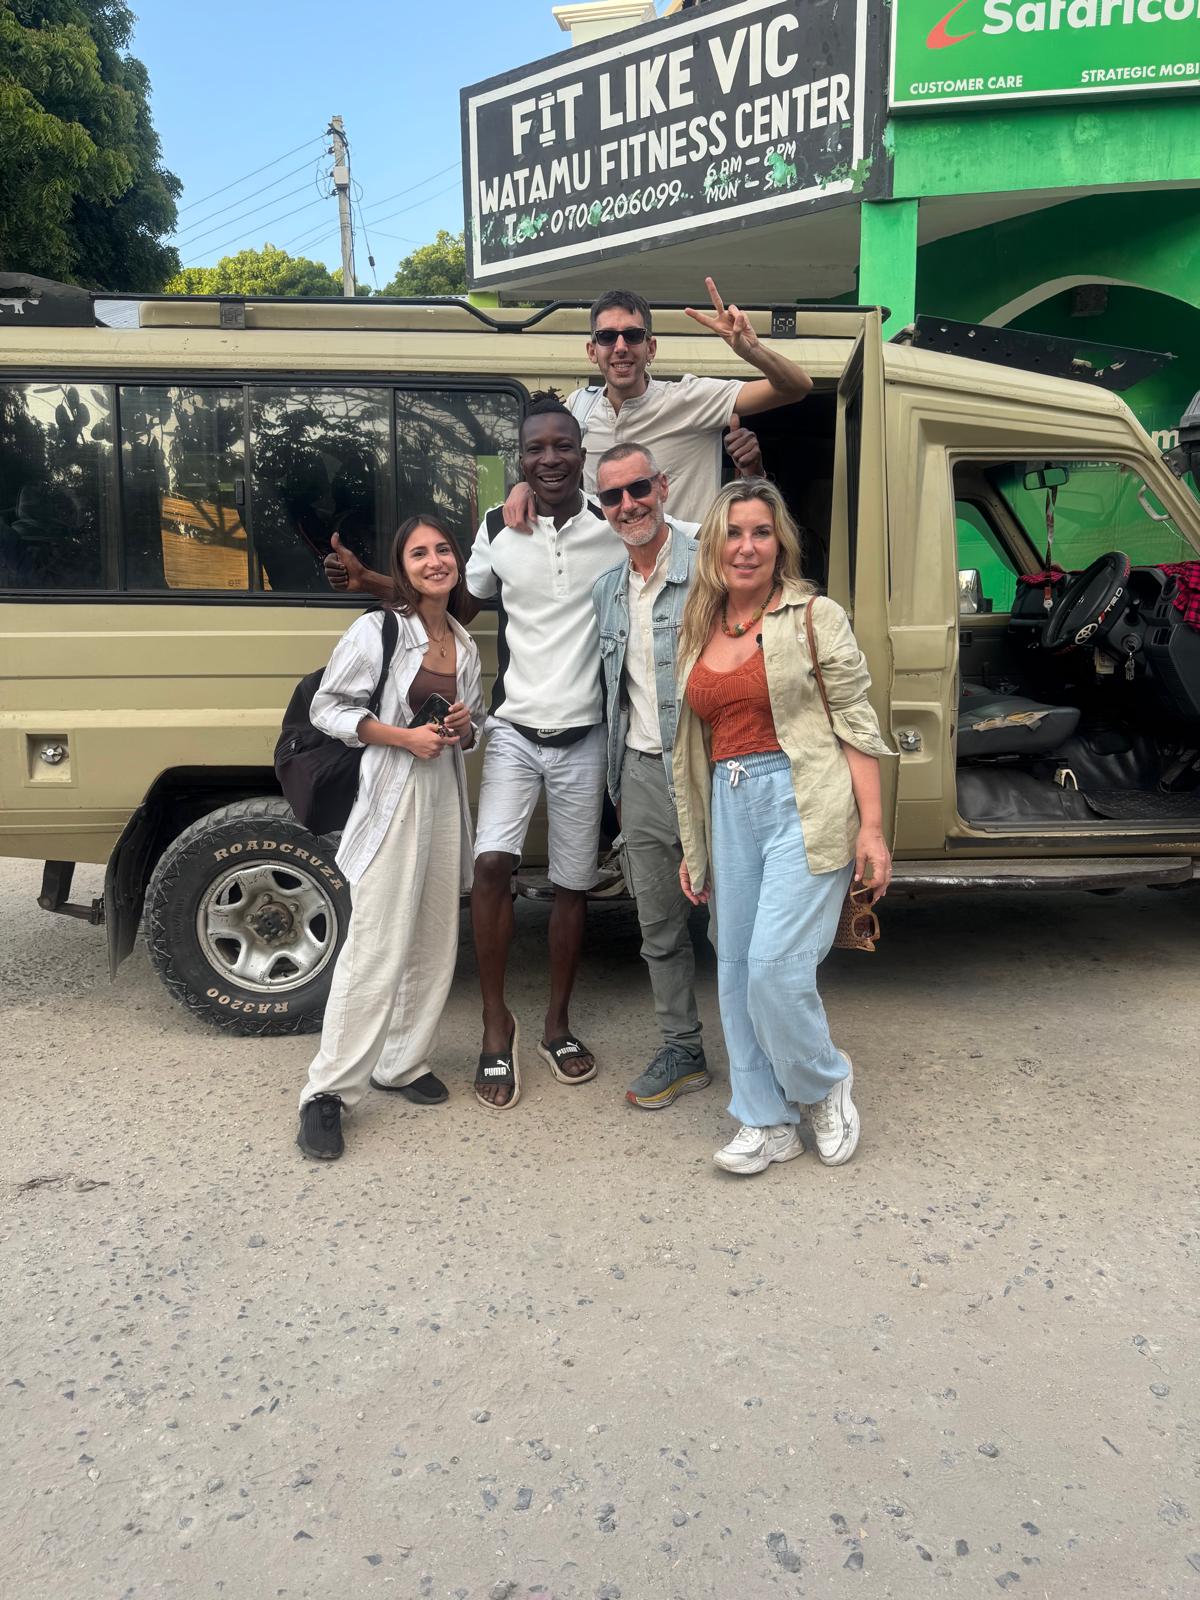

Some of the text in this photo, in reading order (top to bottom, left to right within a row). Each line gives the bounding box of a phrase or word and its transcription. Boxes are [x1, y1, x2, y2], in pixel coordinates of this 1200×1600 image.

[982, 0, 1200, 35] Safarico
[512, 13, 799, 156] FIT LIKE VIC
[909, 75, 1023, 95] CUSTOMER CARE
[1081, 62, 1200, 83] STRATEGIC MOBI
[480, 73, 851, 215] WATAMU FITNESS CENTER
[1104, 587, 1124, 613] TRD
[213, 840, 344, 890] ROADCRUZA
[207, 987, 289, 1014] RA3200
[556, 1046, 579, 1057] PUMA
[484, 1066, 507, 1077] PUMA
